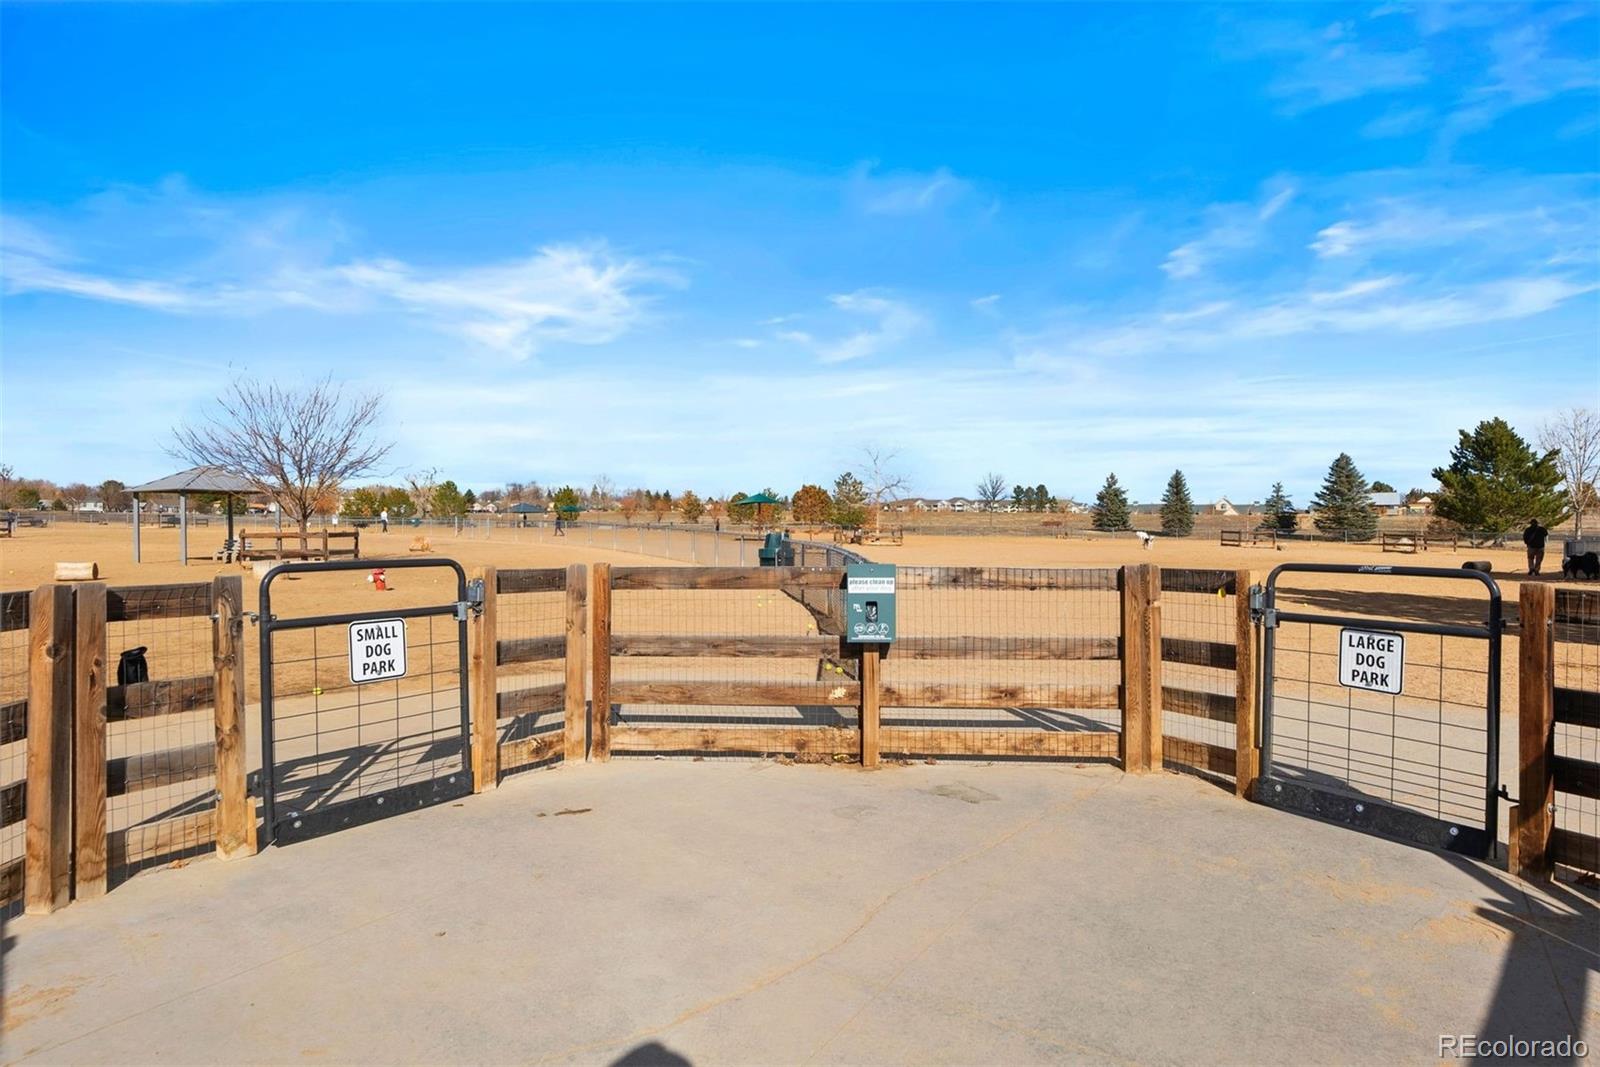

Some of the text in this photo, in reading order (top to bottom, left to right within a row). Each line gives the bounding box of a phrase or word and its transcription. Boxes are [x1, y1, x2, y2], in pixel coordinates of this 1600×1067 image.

[356, 625, 398, 642] SMALL
[365, 642, 392, 658] DOG
[1348, 634, 1395, 653] LARGE
[362, 659, 396, 676] PARK
[1355, 652, 1385, 669] DOG
[1351, 669, 1390, 688] PARK
